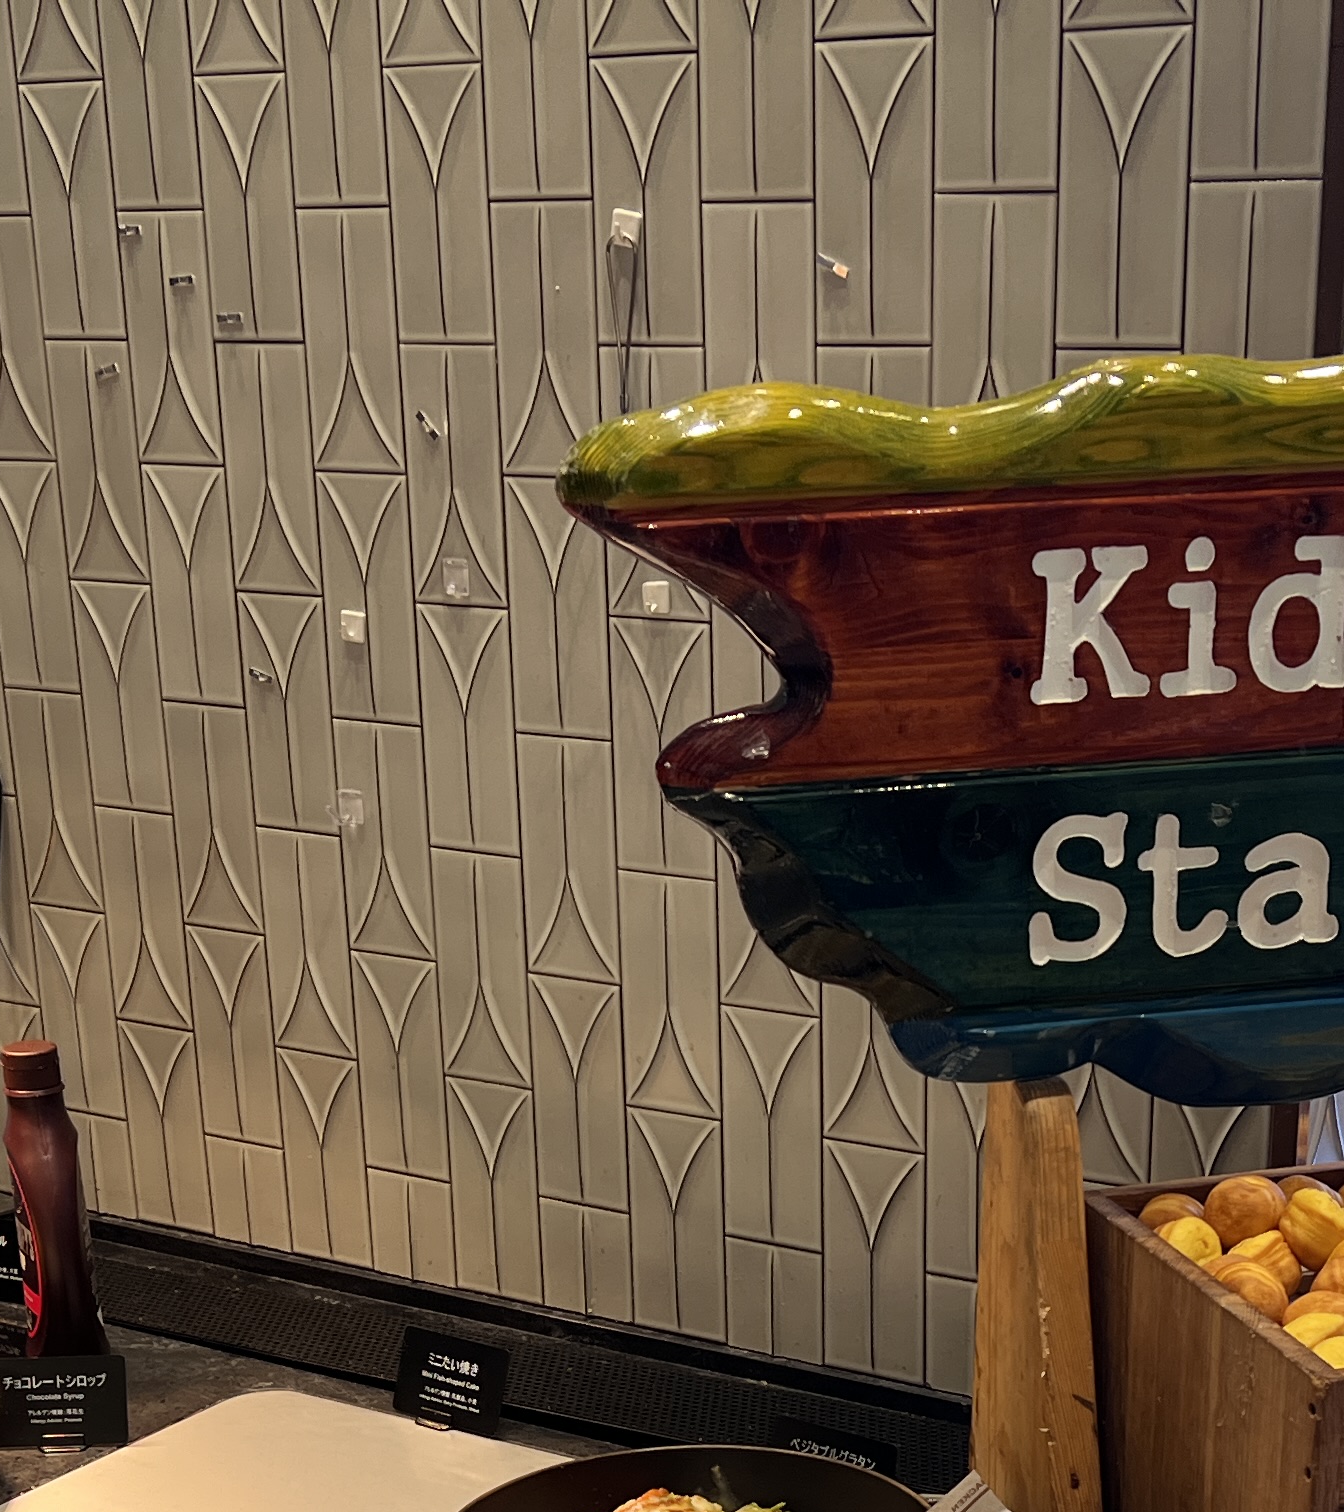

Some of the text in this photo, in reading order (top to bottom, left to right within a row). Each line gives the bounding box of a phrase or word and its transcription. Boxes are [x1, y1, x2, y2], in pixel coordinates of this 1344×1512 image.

[427, 1352, 479, 1377] ミニたい焼き
[1, 1372, 107, 1390] チョコレートシロップ
